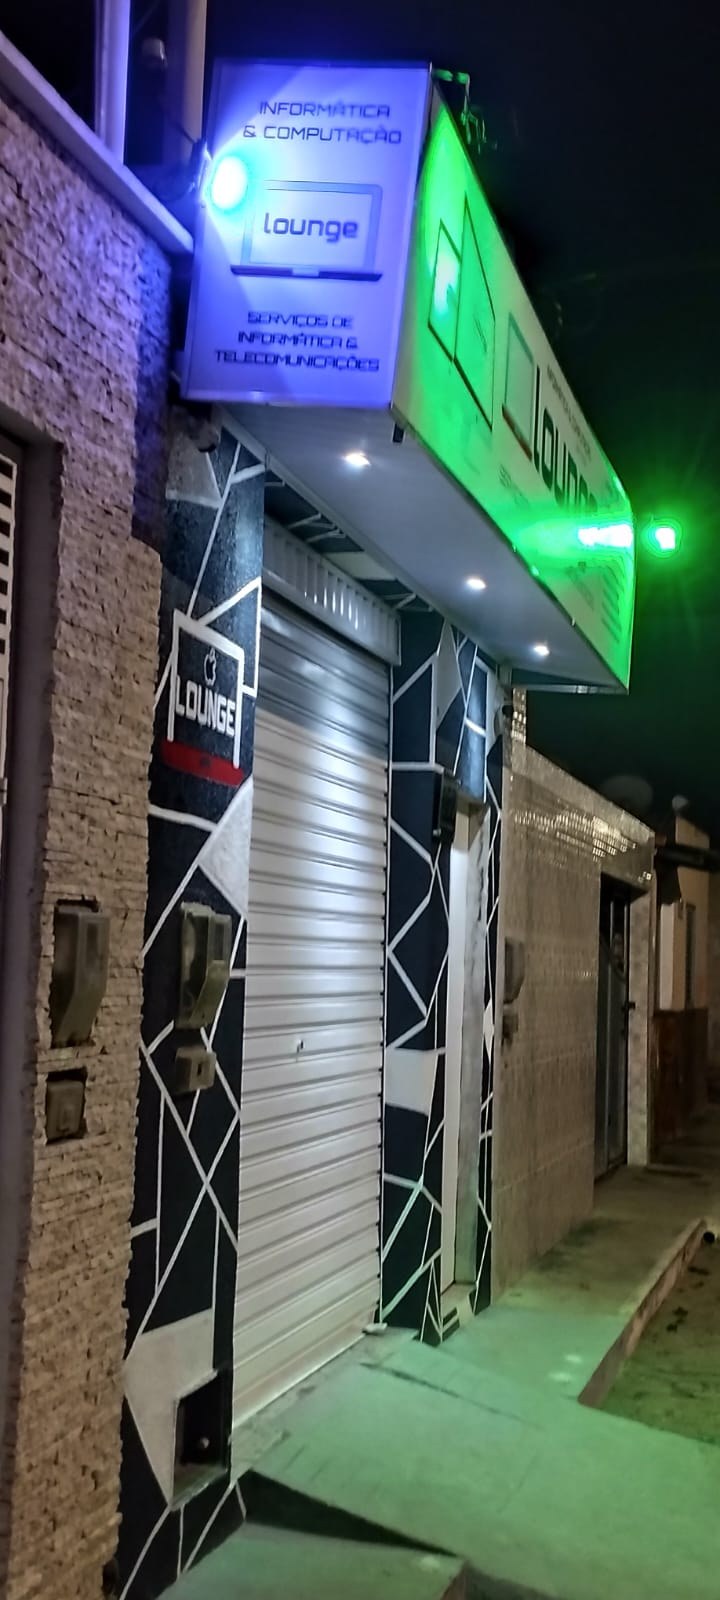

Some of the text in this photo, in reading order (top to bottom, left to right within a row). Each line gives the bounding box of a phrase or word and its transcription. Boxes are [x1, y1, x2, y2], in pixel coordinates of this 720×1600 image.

[259, 101, 390, 119] INFORMÁTICA
[243, 125, 402, 144] & COMPUTAÇÃO
[263, 213, 359, 242] lounge
[247, 311, 353, 329] SERVIÇOS DE
[238, 331, 342, 349] INFORMÁTICA
[215, 349, 380, 372] TELECOMUNICAÇÕES
[533, 364, 598, 514] loun
[175, 675, 237, 737] LOUNGE
